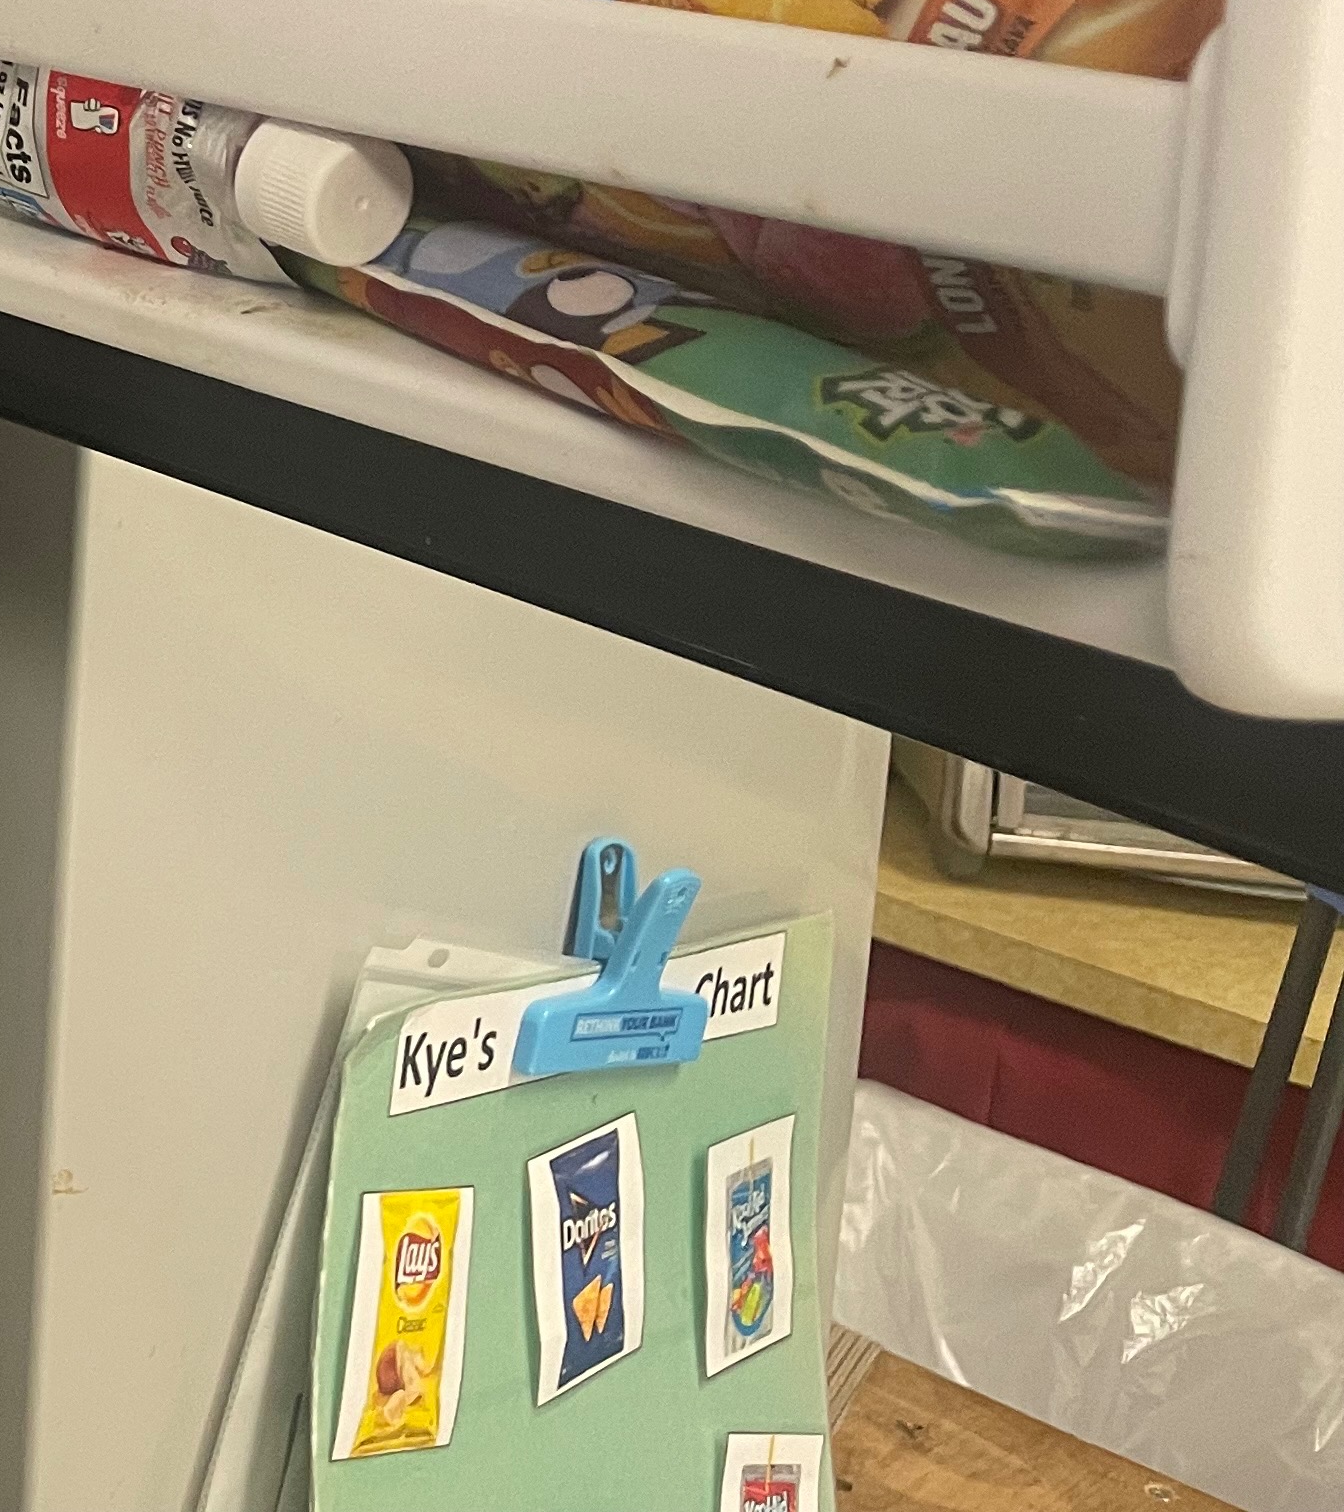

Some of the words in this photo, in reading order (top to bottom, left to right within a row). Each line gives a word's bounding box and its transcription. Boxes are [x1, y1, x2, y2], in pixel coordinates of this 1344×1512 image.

[6, 77, 32, 185] Facts
[172, 121, 198, 147] No
[188, 186, 214, 227] Juice
[399, 1017, 498, 1097] Kye's
[695, 962, 775, 1019] Chart
[397, 1235, 440, 1284] Lay's
[563, 1202, 616, 1251] Doritos
